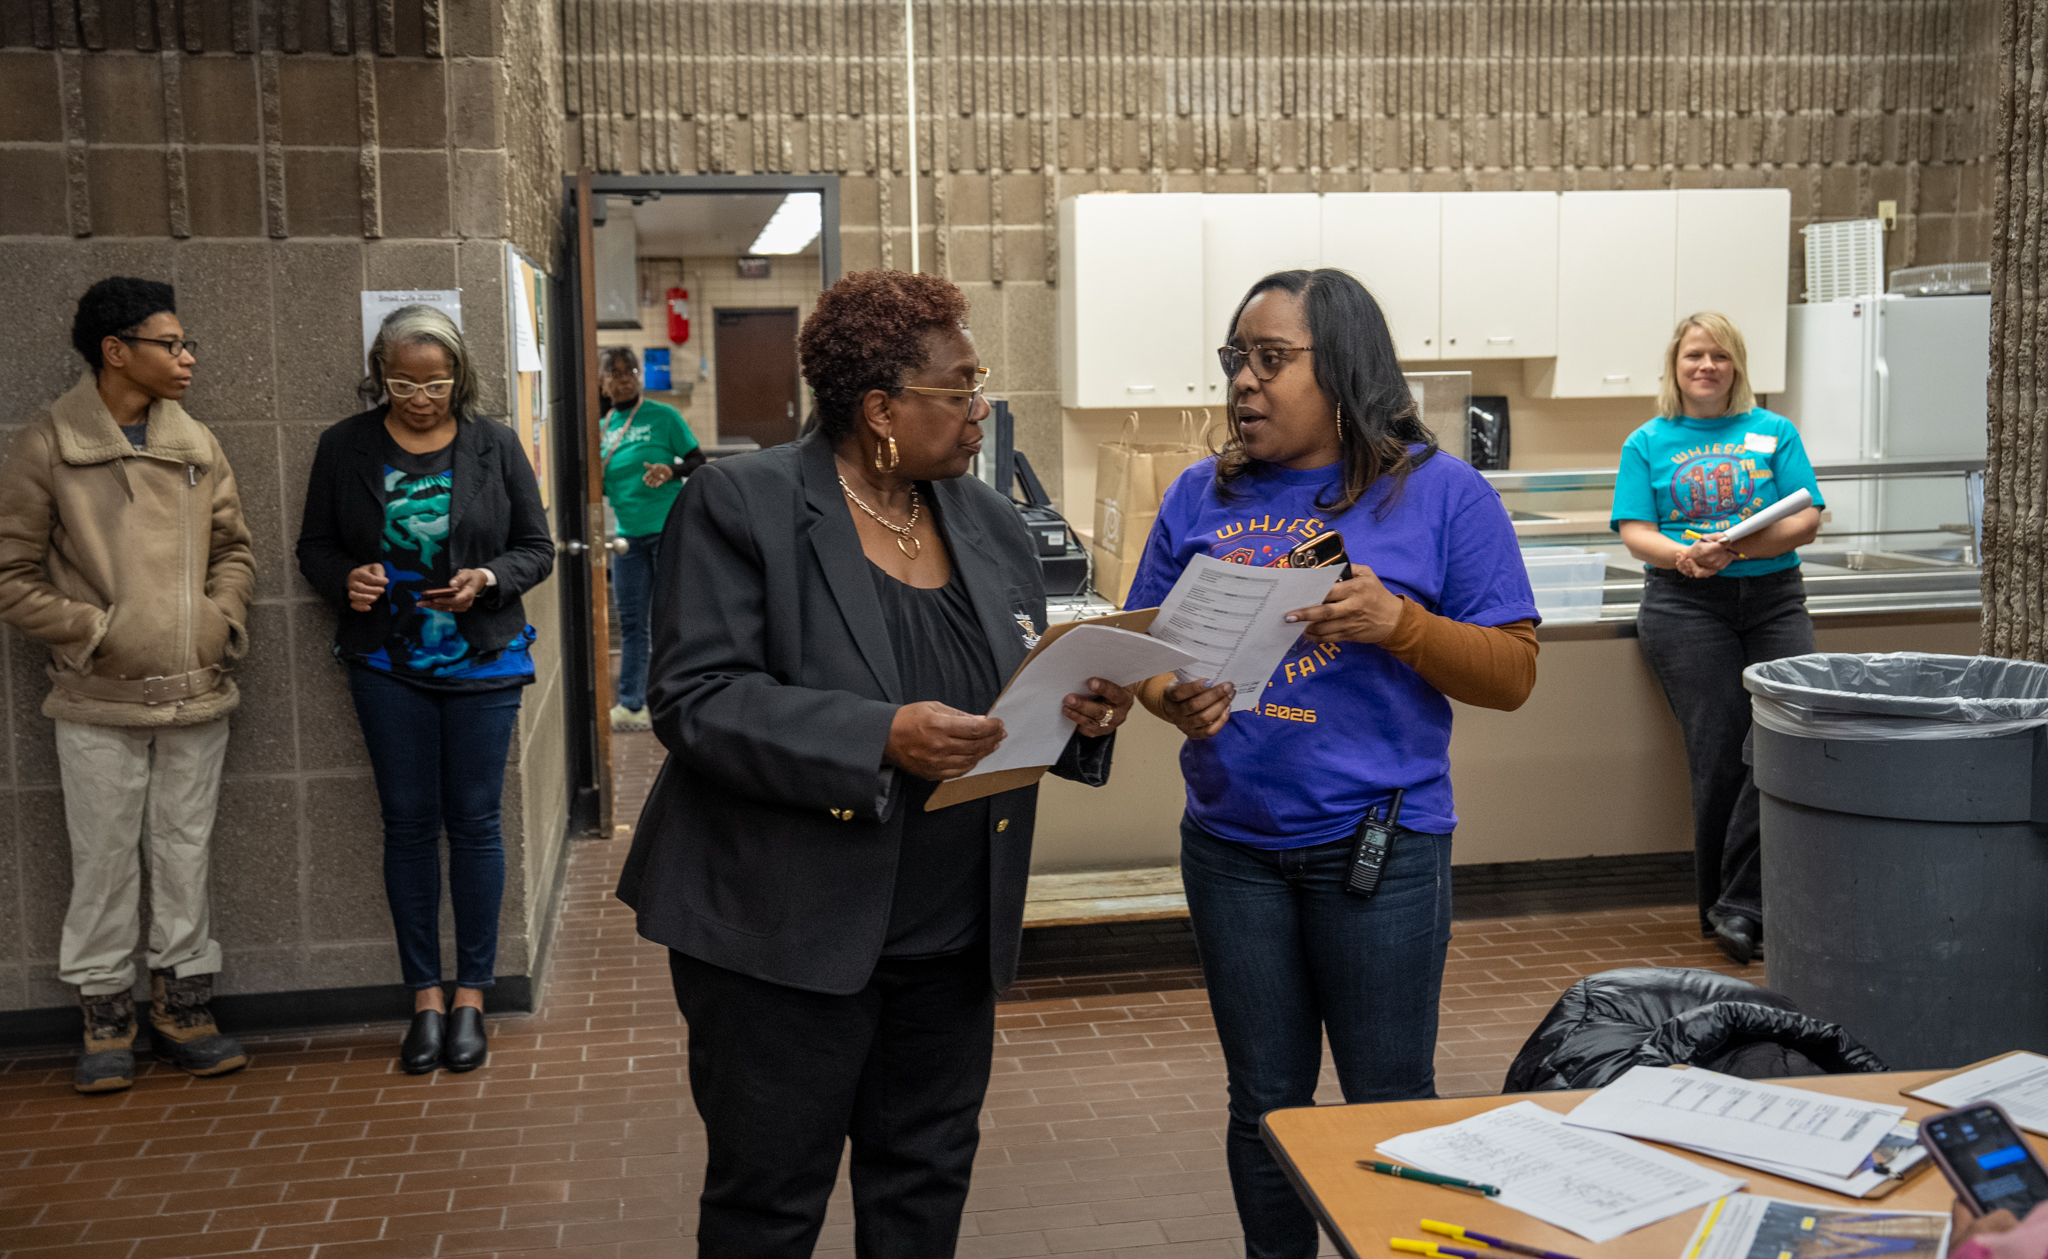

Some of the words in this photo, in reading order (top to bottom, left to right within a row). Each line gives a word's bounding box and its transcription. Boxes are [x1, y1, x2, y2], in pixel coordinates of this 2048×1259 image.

[378, 294, 399, 302] Small
[1739, 459, 1756, 471] TH
[1284, 642, 1342, 684] FAIR
[1264, 702, 1317, 723] 2026
